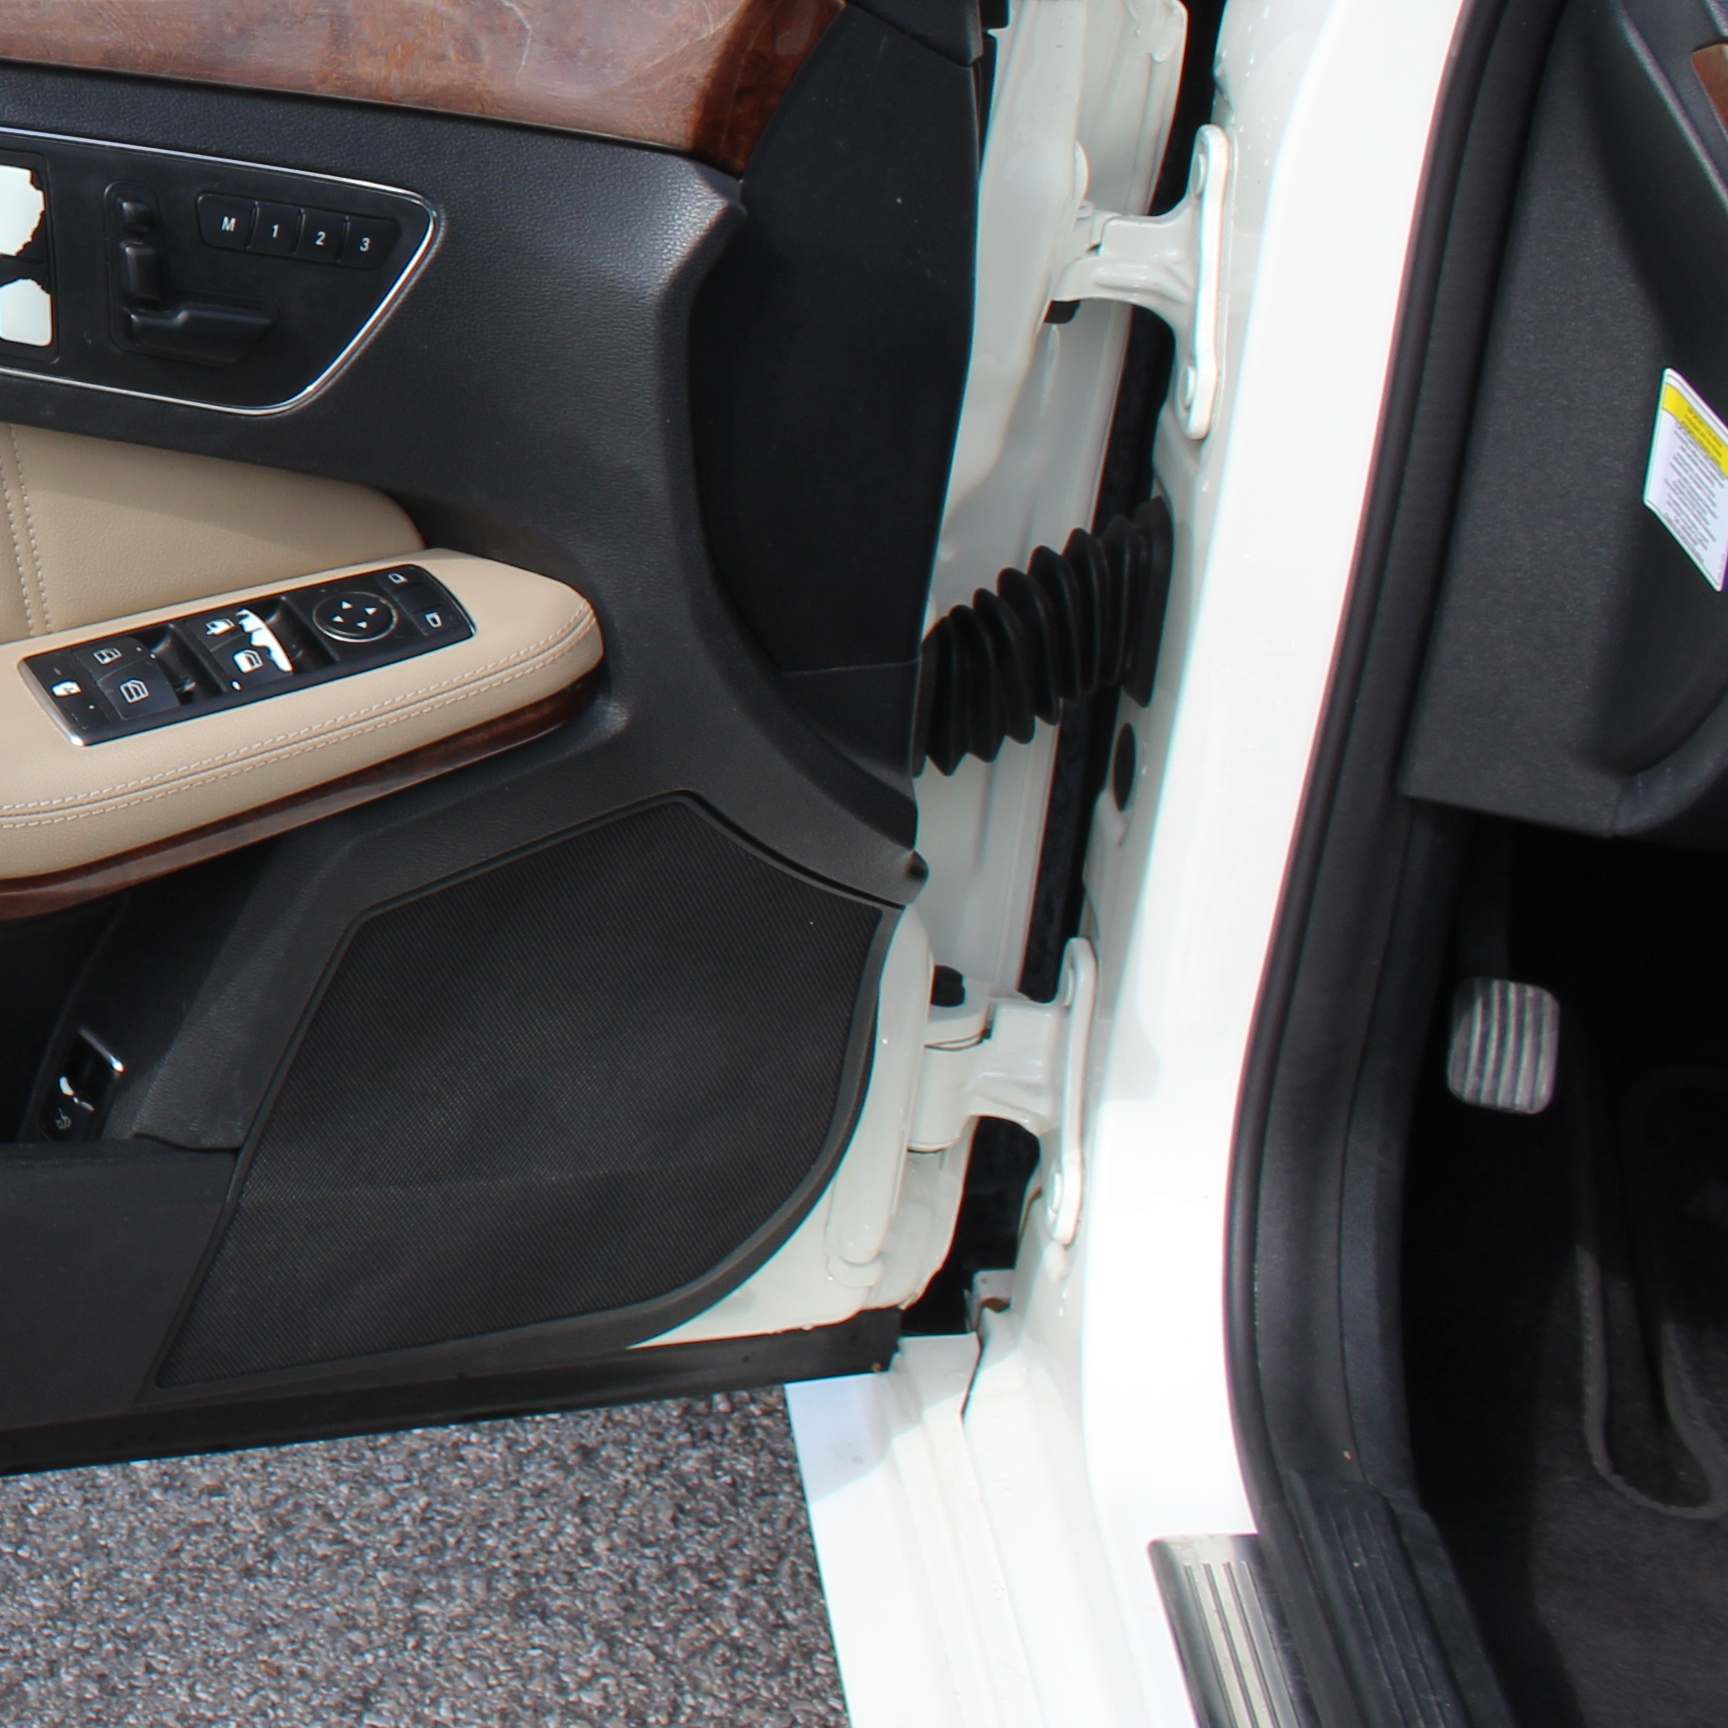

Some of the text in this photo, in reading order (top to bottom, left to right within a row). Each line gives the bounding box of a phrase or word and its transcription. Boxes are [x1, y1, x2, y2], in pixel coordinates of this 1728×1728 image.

[221, 216, 371, 252] M 1 2 3
